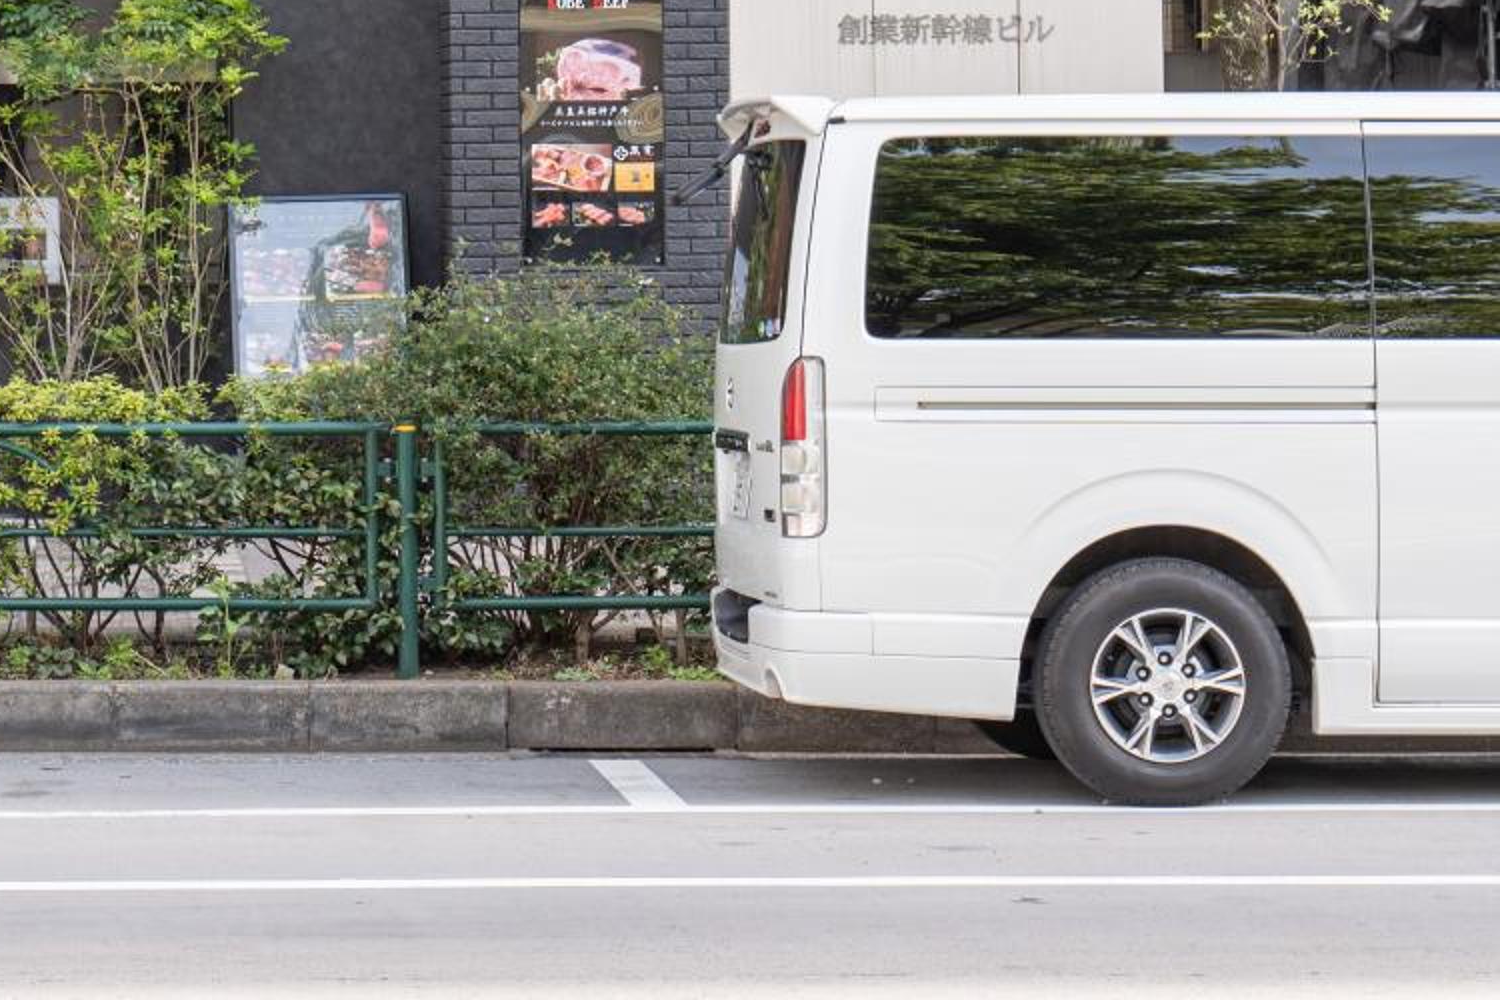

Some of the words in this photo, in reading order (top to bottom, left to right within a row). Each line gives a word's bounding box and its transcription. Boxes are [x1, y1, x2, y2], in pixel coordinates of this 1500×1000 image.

[837, 13, 1055, 46] 創業新幹線ビル
